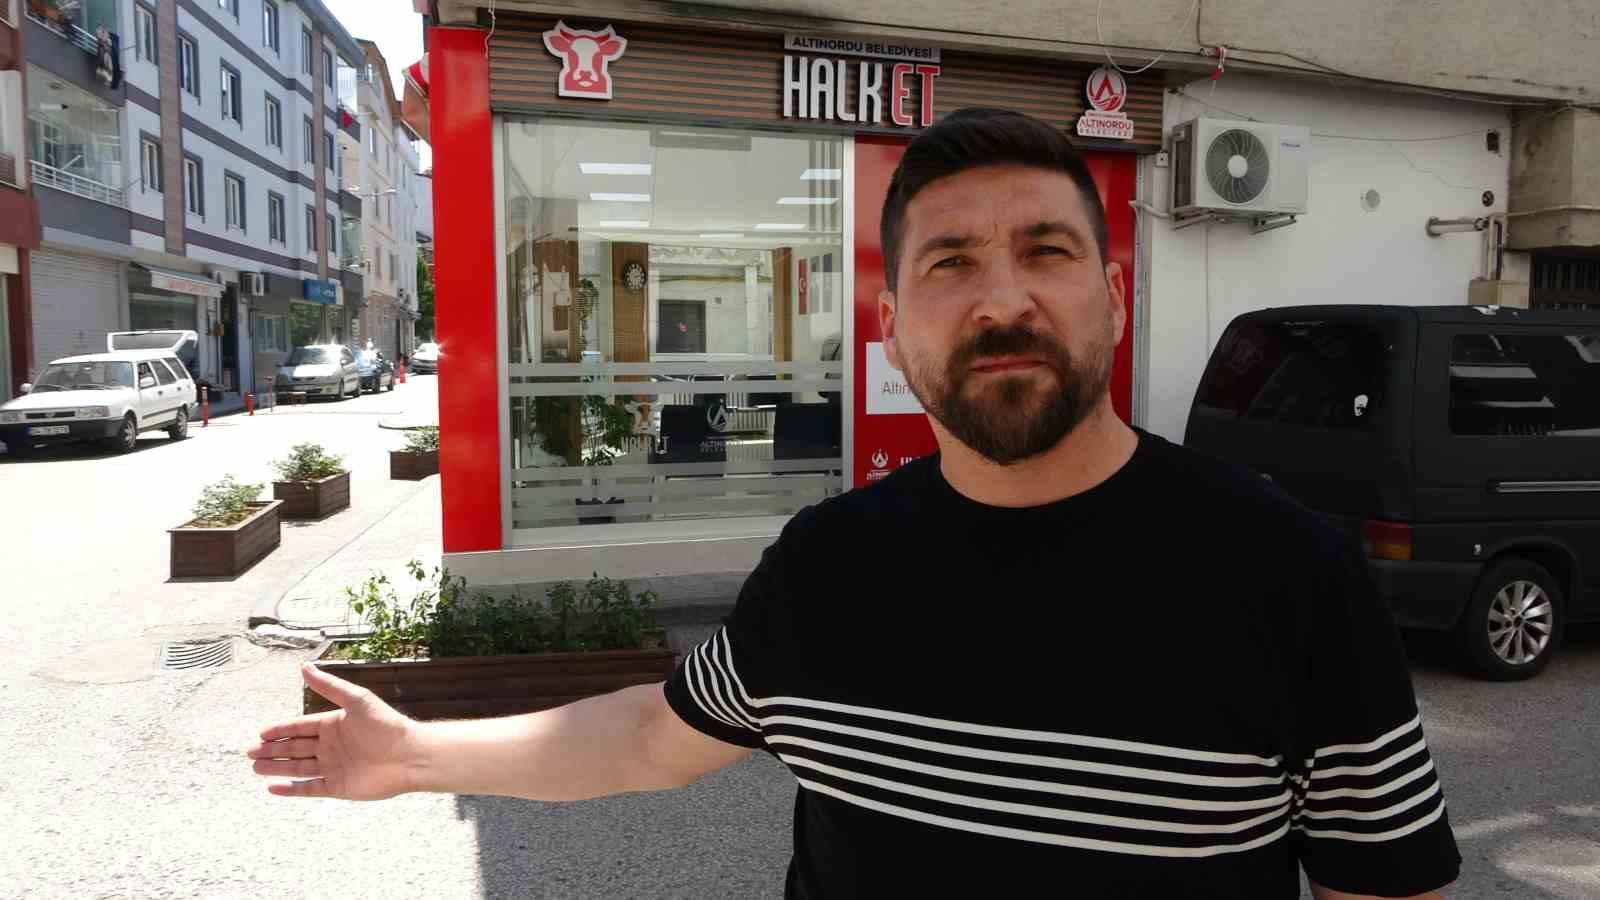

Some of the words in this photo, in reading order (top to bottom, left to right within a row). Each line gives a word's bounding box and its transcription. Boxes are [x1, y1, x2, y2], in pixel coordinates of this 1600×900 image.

[792, 36, 864, 51] ALTINORDU
[1079, 118, 1132, 130] ALTINORDU
[882, 381, 912, 395] Altın
